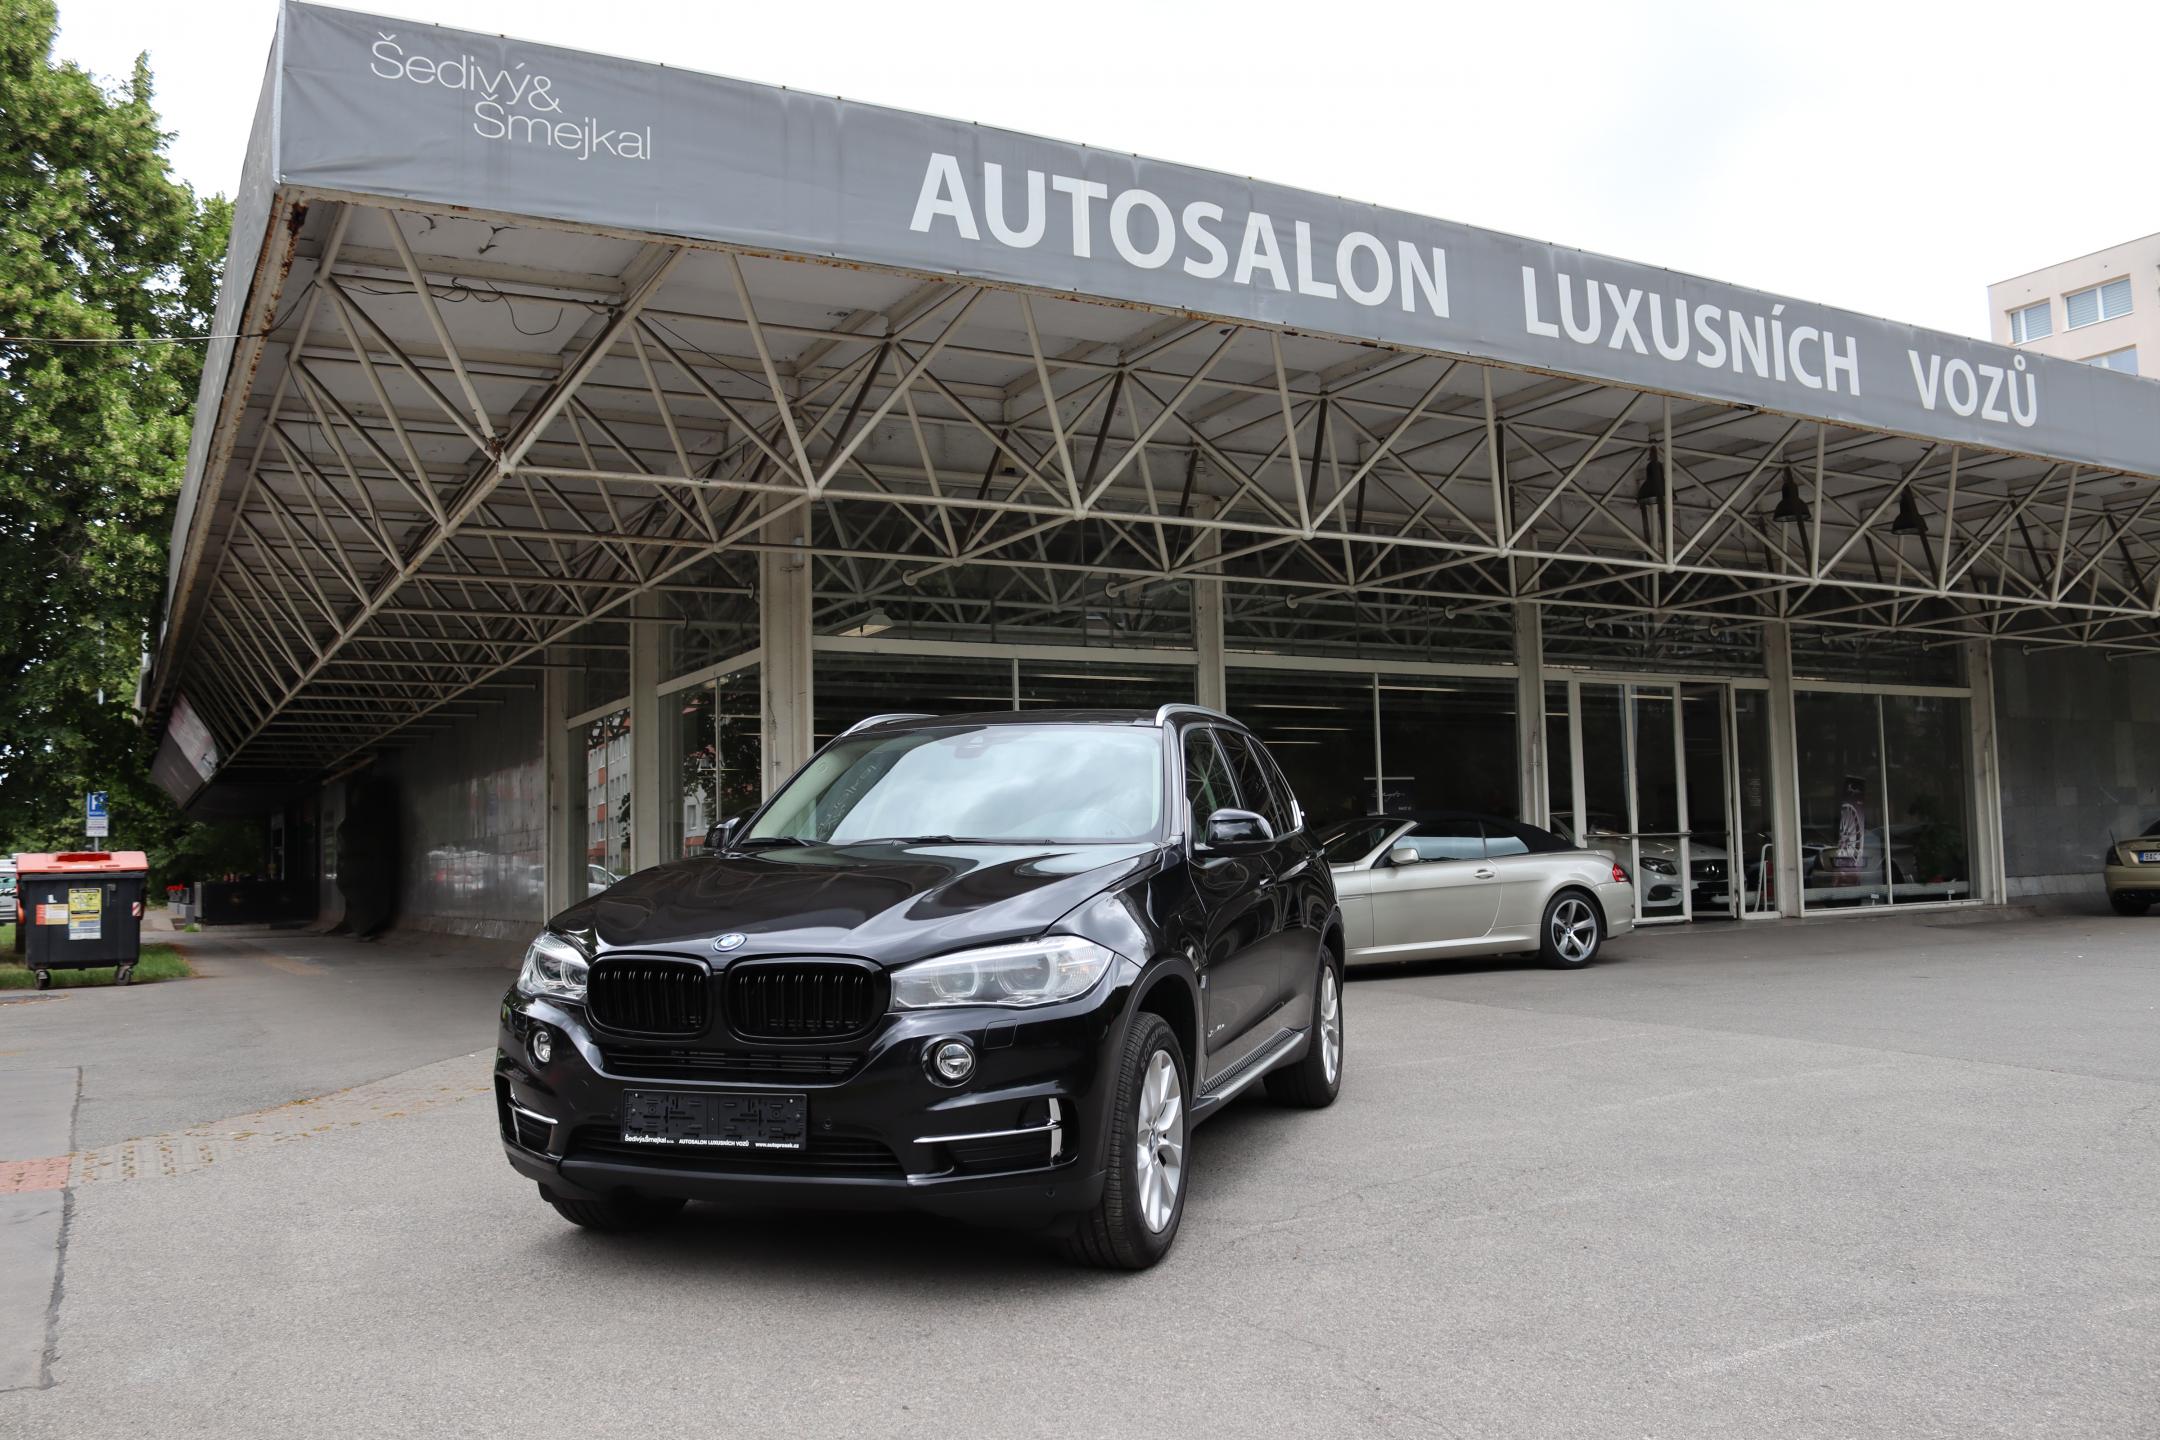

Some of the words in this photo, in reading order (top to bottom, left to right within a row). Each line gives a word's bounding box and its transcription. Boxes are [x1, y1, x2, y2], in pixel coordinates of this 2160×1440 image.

[370, 31, 562, 113] Šedivý&
[473, 91, 651, 161] Šmejkal
[909, 152, 1450, 318] AUTOSALON
[1522, 266, 1860, 396] LUXUSNÍCH
[1908, 349, 2038, 427] VOZŮ
